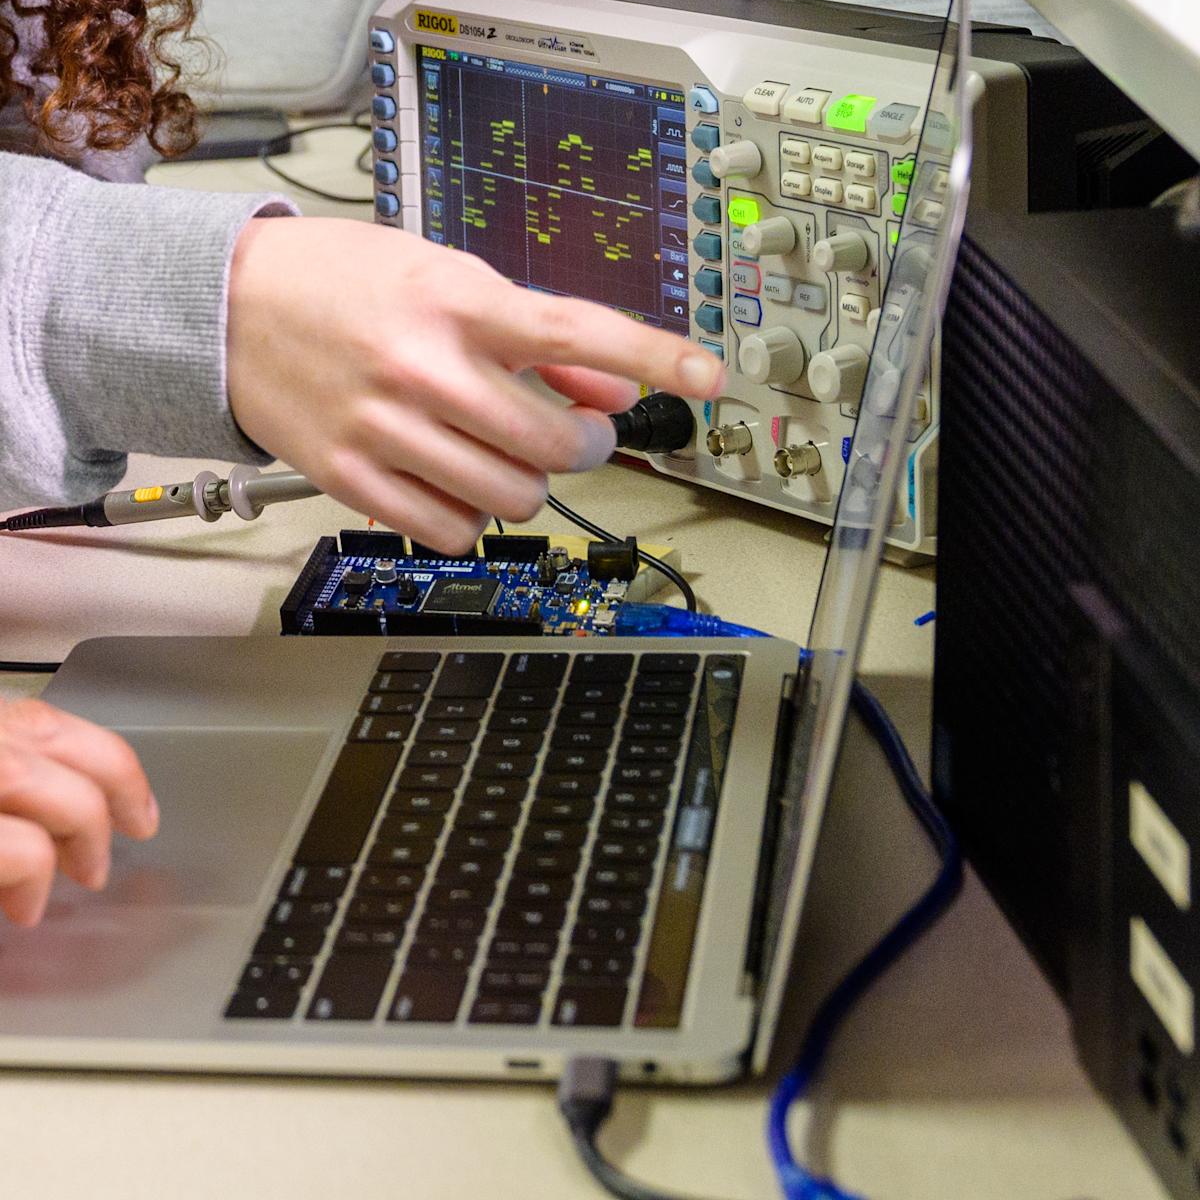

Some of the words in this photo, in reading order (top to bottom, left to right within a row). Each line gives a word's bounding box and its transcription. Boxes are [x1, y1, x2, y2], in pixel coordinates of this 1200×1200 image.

[418, 13, 456, 33] RIGOL
[422, 47, 446, 60] RIGOL
[754, 87, 775, 97] CLEAR
[796, 96, 814, 105] AUTO
[840, 102, 855, 111] RUN
[835, 108, 853, 119] STOP
[879, 110, 905, 120] SINGLE
[846, 158, 865, 170] Storage
[782, 178, 801, 190] Cursor
[814, 184, 833, 197] Display
[847, 192, 864, 204] Utility
[732, 208, 745, 218] CH1
[670, 251, 686, 263] Back
[733, 273, 747, 284] CH3
[670, 287, 686, 298] Undo
[764, 284, 780, 294] MATH
[799, 292, 811, 301] REF
[733, 306, 747, 316] CH4
[842, 303, 860, 314] MENU
[443, 582, 482, 592] Atmel
